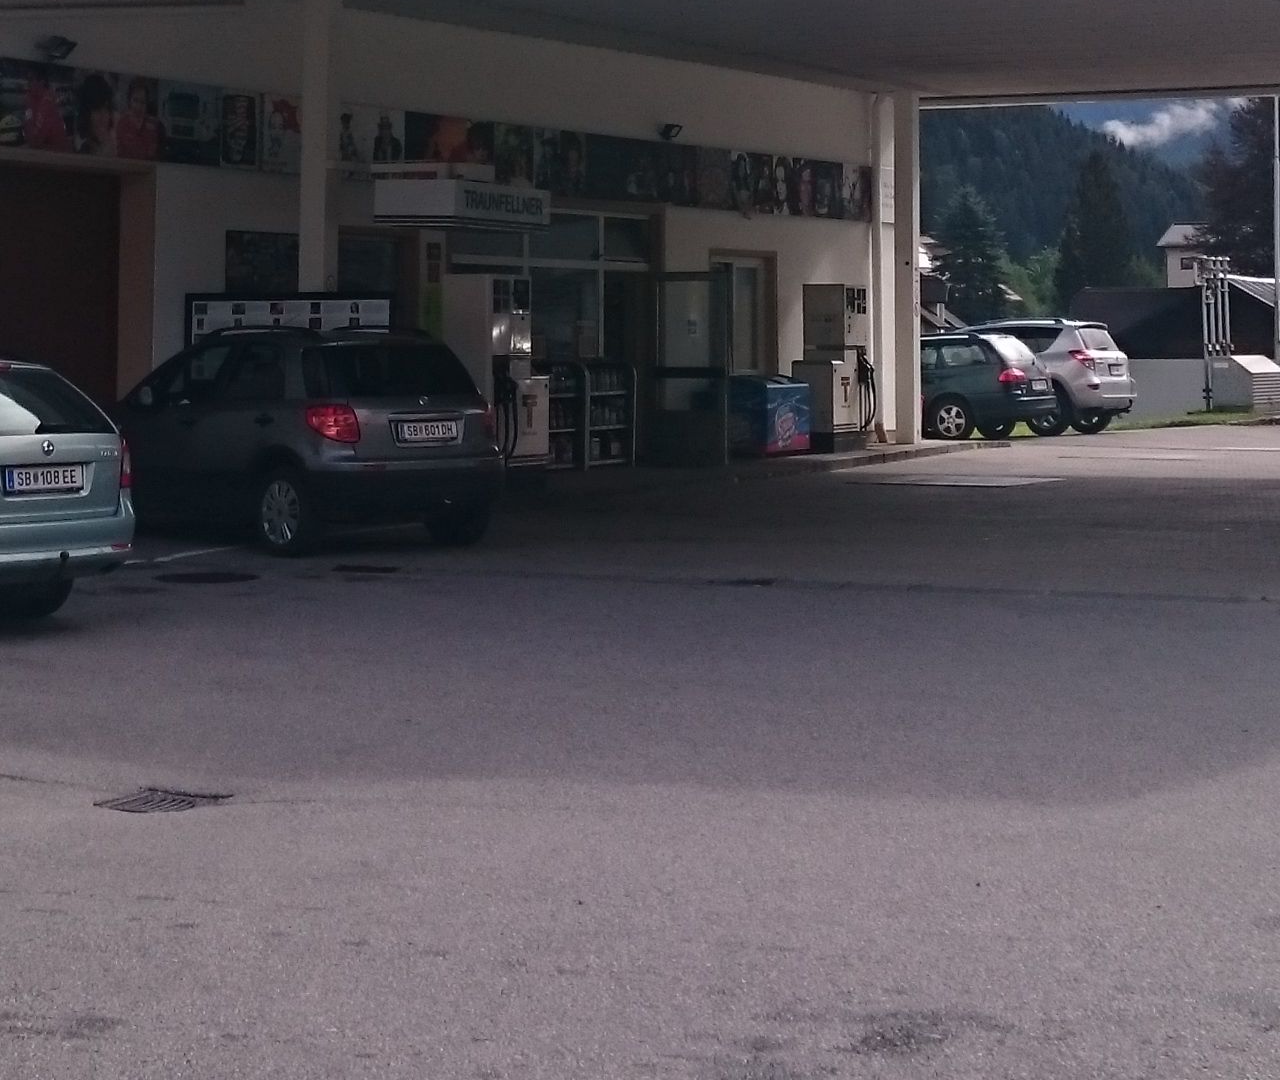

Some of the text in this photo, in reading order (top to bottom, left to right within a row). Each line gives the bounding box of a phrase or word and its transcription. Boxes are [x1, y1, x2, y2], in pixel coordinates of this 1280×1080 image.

[463, 189, 543, 216] TRAUNFELLNER
[407, 424, 419, 437] SB
[17, 469, 77, 487] SB 108 EE
